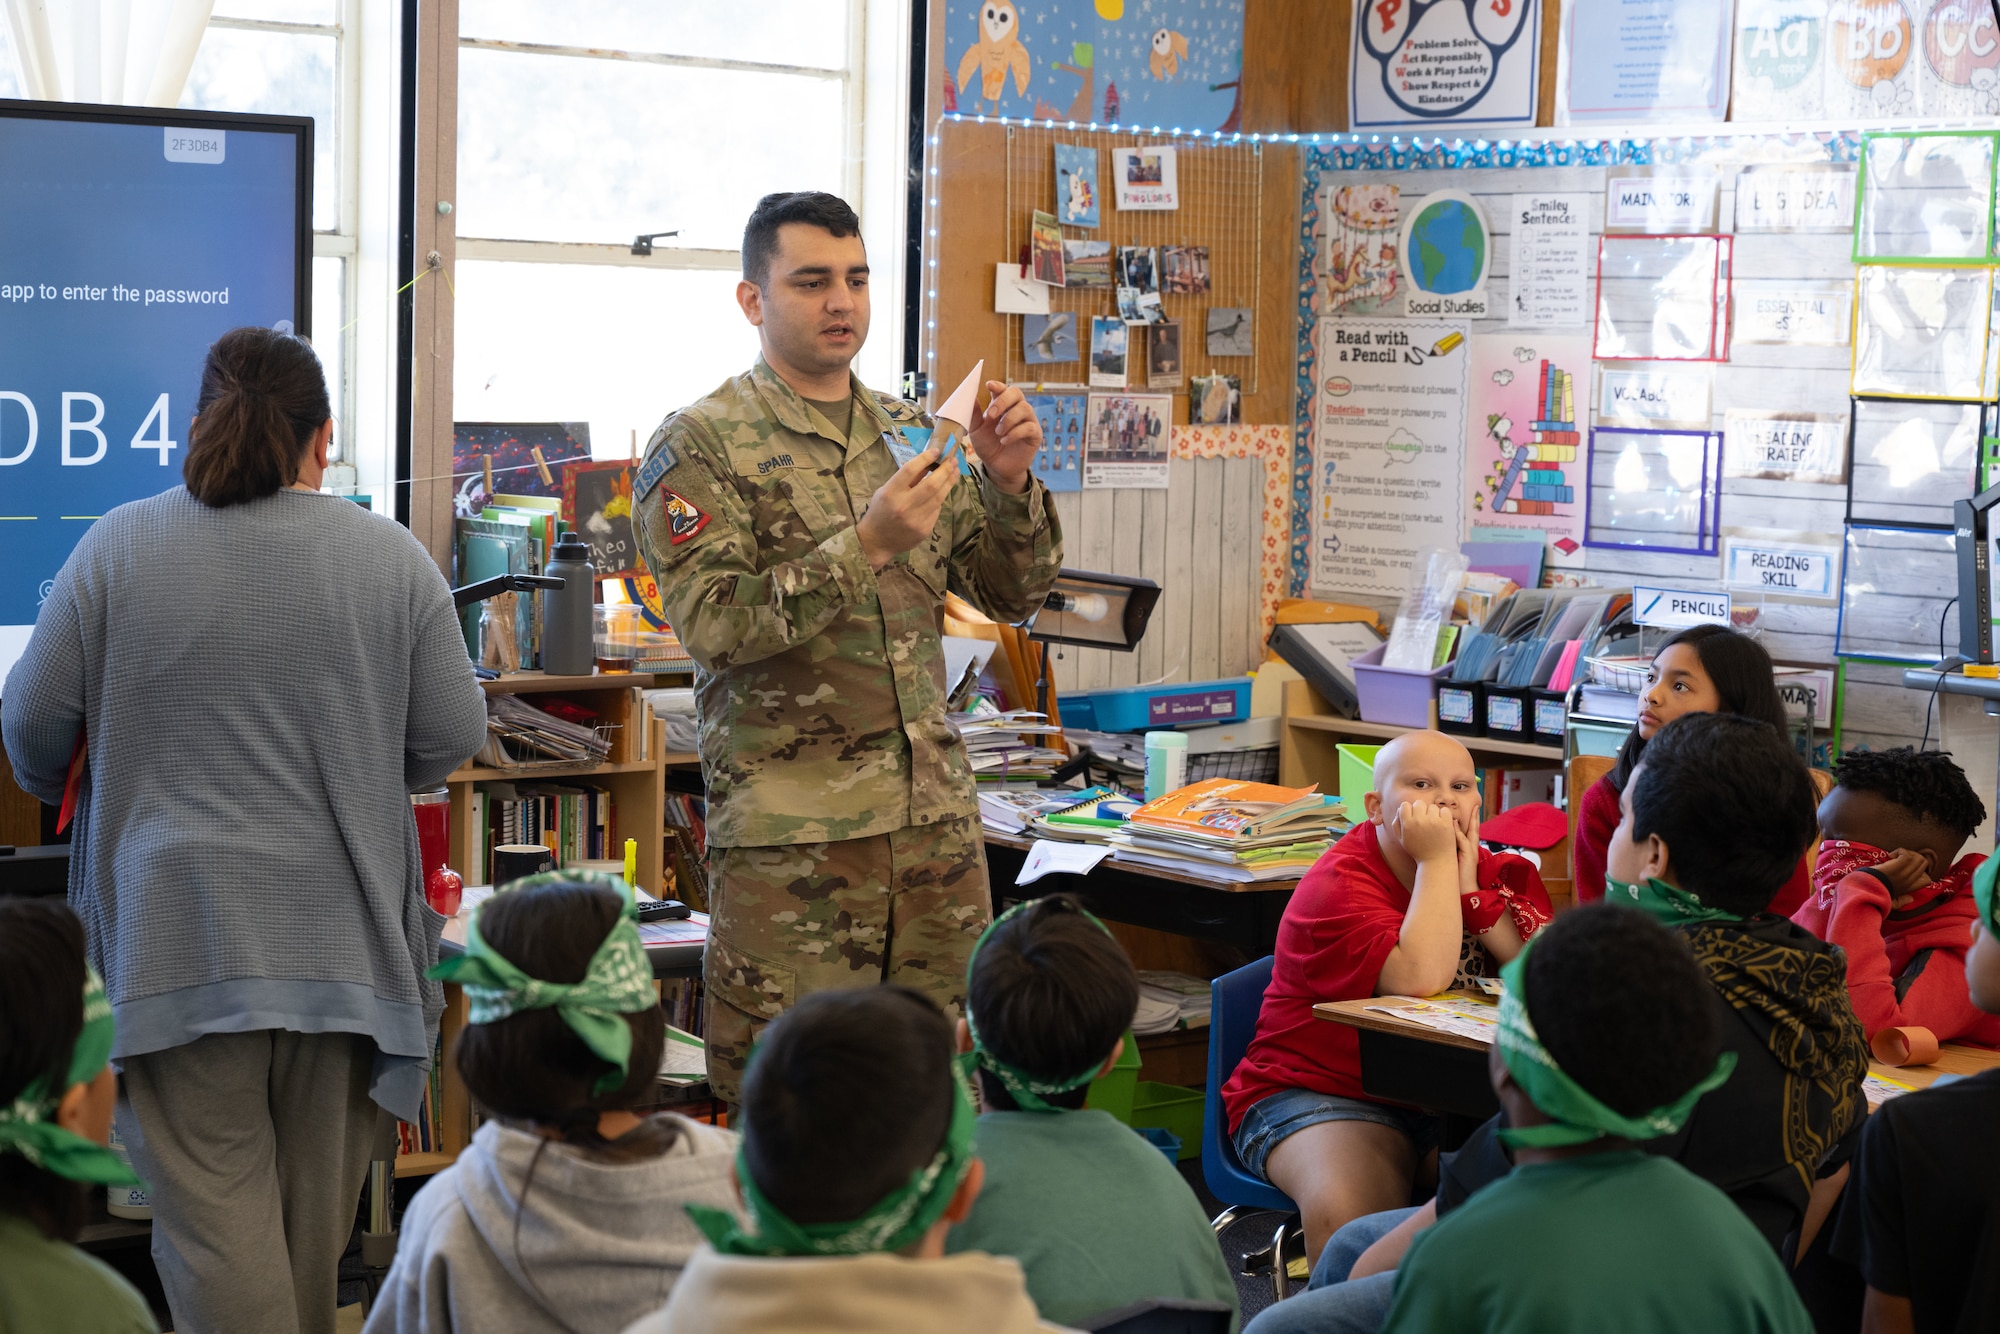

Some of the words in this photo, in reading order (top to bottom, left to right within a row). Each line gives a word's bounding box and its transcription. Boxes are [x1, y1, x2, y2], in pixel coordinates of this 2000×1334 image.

[1749, 12, 1808, 59] Aa
[1848, 9, 1903, 60] Bb
[1936, 5, 1997, 57] Cc
[1406, 39, 1449, 51] Problem
[1452, 39, 1480, 48] Solve
[1401, 54, 1418, 64] Act
[1421, 52, 1482, 64] Responsibly
[1395, 67, 1422, 78] Work
[1425, 68, 1432, 76] &
[1434, 67, 1455, 78] Play
[1458, 65, 1488, 77] Safely
[1402, 80, 1429, 91] Show
[1432, 80, 1470, 91] Respect
[1473, 80, 1481, 88] &
[1418, 94, 1464, 104] Kindness
[171, 138, 218, 153] 2F3DB4
[1532, 199, 1568, 214] Smiley
[1522, 212, 1576, 224] Sentences
[1, 285, 34, 304] app
[39, 284, 57, 300] to
[62, 285, 107, 302] enter
[112, 284, 140, 303] the
[144, 286, 229, 307] password
[1409, 299, 1441, 314] Social
[1444, 299, 1485, 313] Studies
[1336, 330, 1370, 344] Read
[1375, 332, 1409, 345] with
[1340, 351, 1347, 361] a
[1352, 348, 1397, 363] Pencil
[1327, 382, 1350, 391] Circle
[1353, 385, 1385, 393] powerful
[1387, 385, 1409, 393] words
[1411, 386, 1425, 394] and
[1427, 387, 1457, 397] phrases.
[1326, 405, 1365, 415] Underline
[1368, 407, 1389, 415] words
[1401, 409, 1430, 418] phrases
[1326, 417, 1344, 425] don't
[1346, 417, 1389, 426] understand.
[1324, 439, 1343, 447] Write
[1346, 440, 1382, 450] important
[1386, 442, 1422, 452] thoughts
[1434, 445, 1447, 453] the
[635, 446, 673, 496] 1SGT
[757, 454, 795, 474] SPAHR
[1336, 474, 1351, 482] This
[1353, 476, 1375, 484] raises
[1384, 478, 1415, 487] question
[1417, 478, 1441, 488] (write
[1323, 486, 1339, 494] your
[1341, 486, 1372, 495] question
[1397, 490, 1430, 499] margin).
[1334, 508, 1349, 516] This
[1351, 509, 1386, 519] surprised
[1401, 512, 1422, 522] (note
[1424, 514, 1443, 522] what
[1323, 519, 1346, 528] caught
[1348, 522, 1365, 530] your
[1368, 522, 1407, 533] attention).
[1957, 528, 1972, 537] AVer
[1350, 545, 1369, 553] made
[1352, 557, 1368, 565] text,
[1370, 558, 1388, 567] idea,
[1752, 554, 1809, 571] READING
[1322, 565, 1343, 574] (write
[1352, 568, 1376, 577] down).
[1762, 572, 1797, 588] SKILL
[647, 583, 657, 598] 8
[1672, 600, 1725, 616] PENCILS
